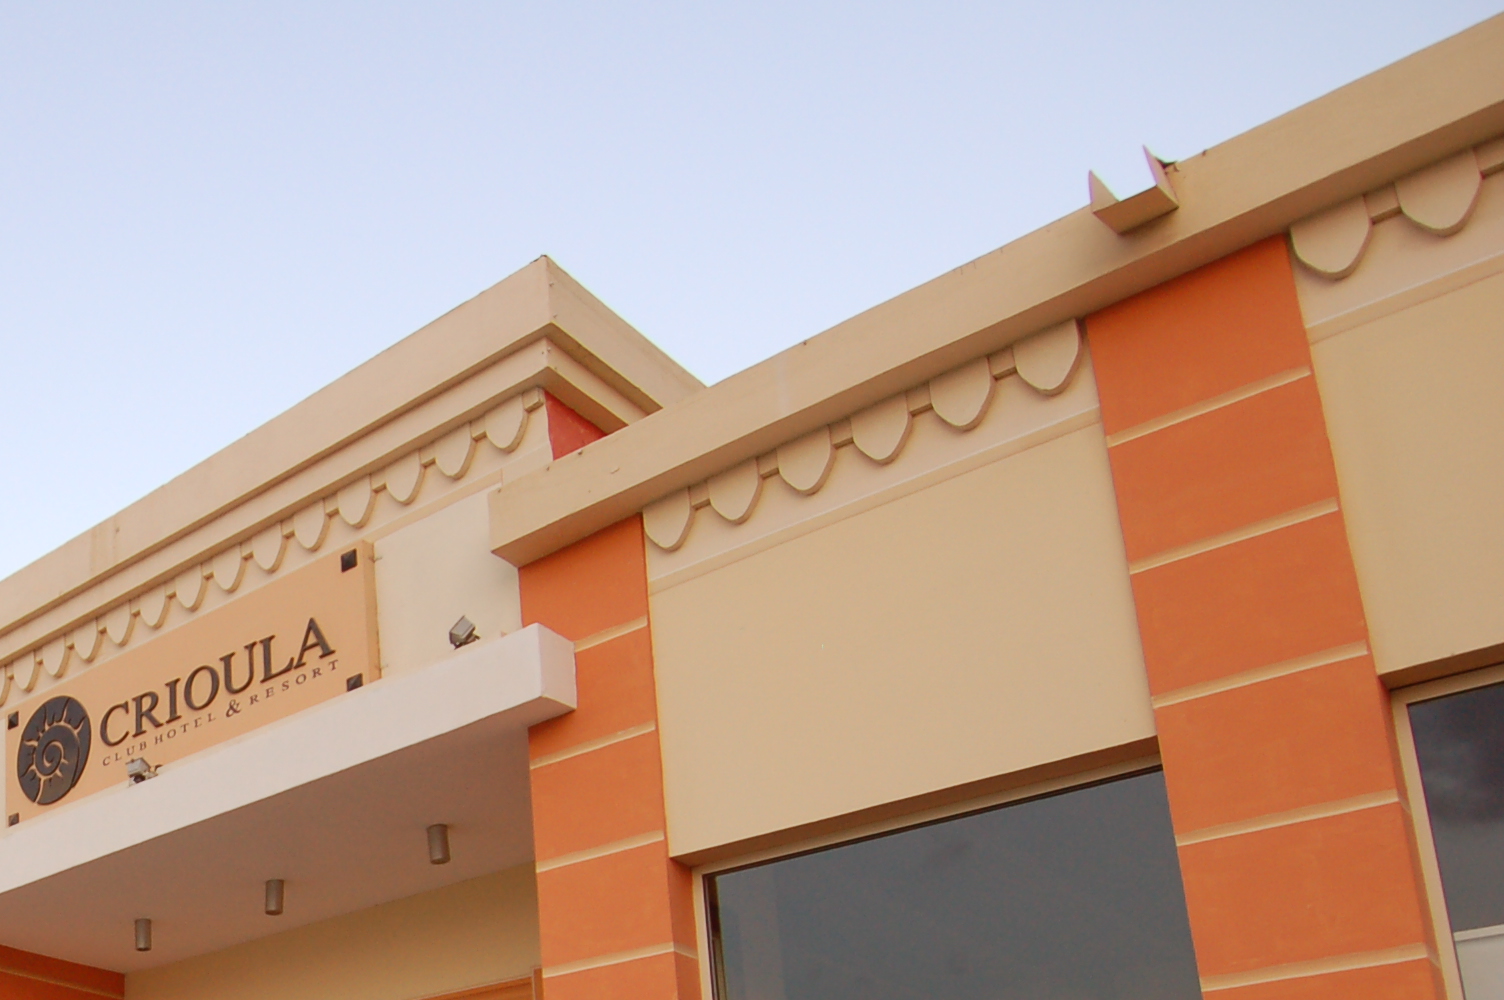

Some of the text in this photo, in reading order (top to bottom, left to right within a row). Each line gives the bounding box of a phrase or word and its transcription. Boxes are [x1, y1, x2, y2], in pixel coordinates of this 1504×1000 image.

[100, 617, 336, 747] CRIOULA
[102, 659, 338, 766] CLUB HOTEL & RESORT
